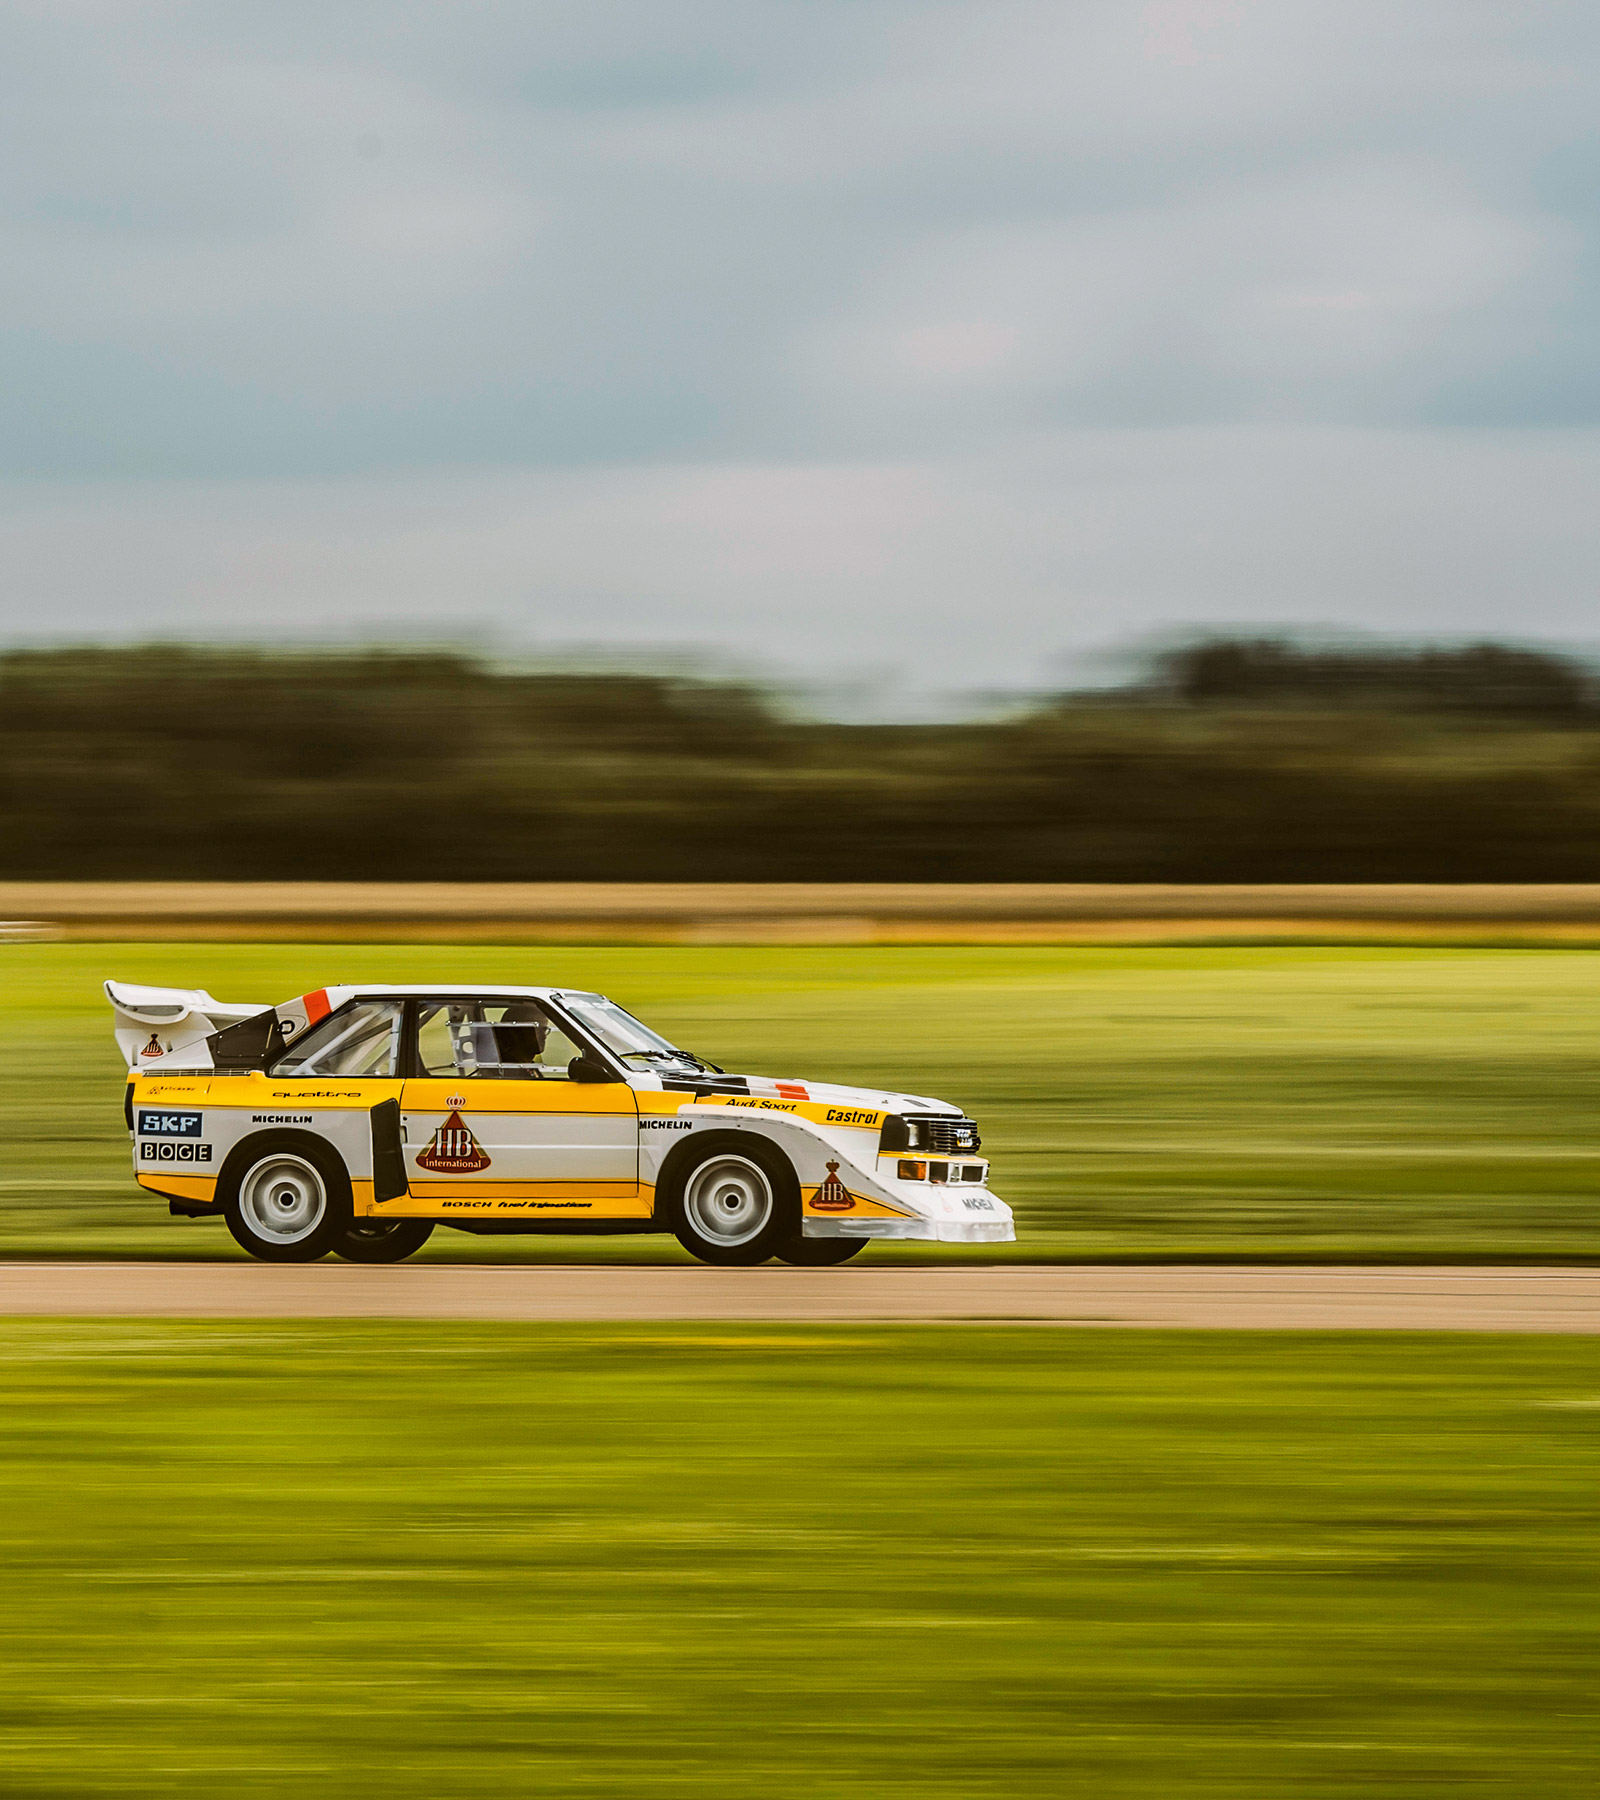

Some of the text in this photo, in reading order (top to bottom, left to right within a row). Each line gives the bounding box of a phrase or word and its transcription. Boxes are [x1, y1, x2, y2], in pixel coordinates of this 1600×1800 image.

[725, 1098, 797, 1111] Audi Sport
[143, 1115, 198, 1131] SKF
[252, 1115, 313, 1123] MICHELIN
[826, 1109, 879, 1124] Castrol
[639, 1120, 693, 1129] MICHELIN
[435, 1127, 473, 1157] HB
[144, 1144, 208, 1160] BOGE
[425, 1158, 482, 1168] international
[820, 1183, 844, 1201] HB
